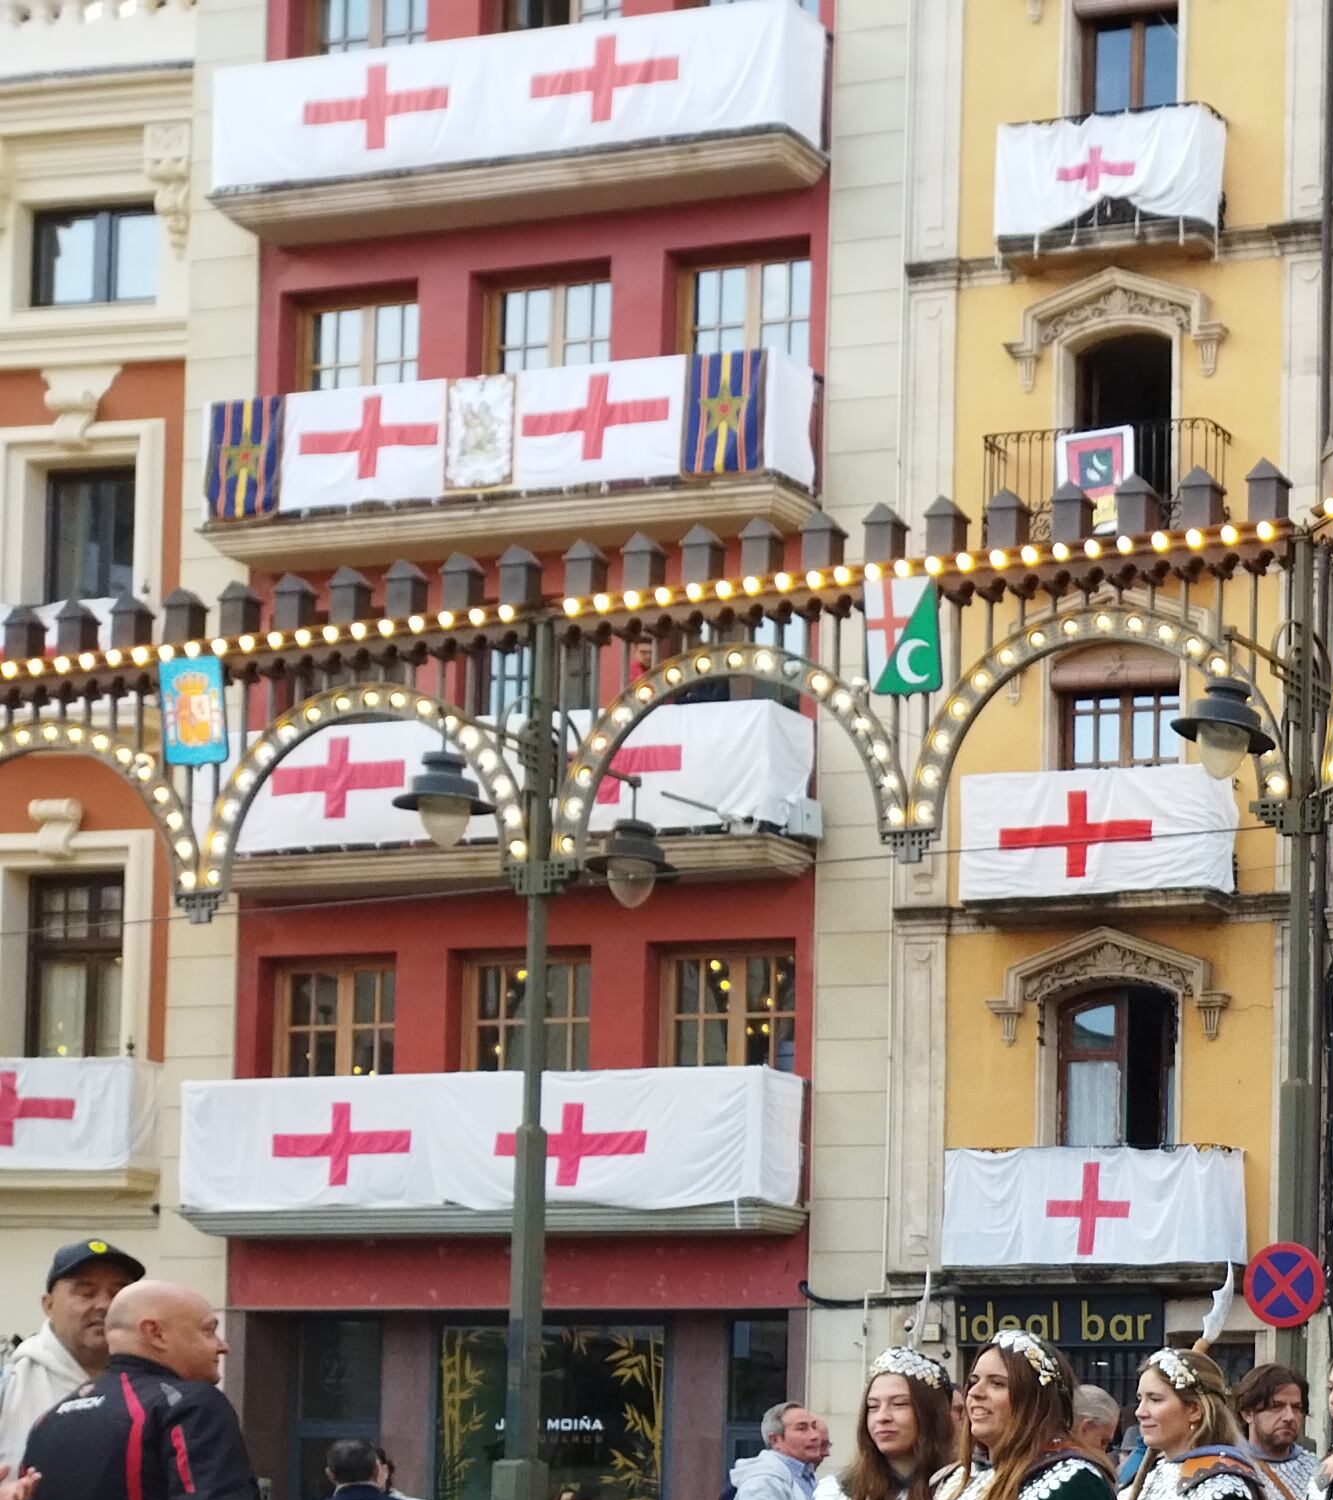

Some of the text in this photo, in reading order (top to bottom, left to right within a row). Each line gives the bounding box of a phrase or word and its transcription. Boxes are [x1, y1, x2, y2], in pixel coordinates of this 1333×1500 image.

[960, 1300, 1152, 1342] ideal bar
[546, 1415, 604, 1431] MOIÑA
